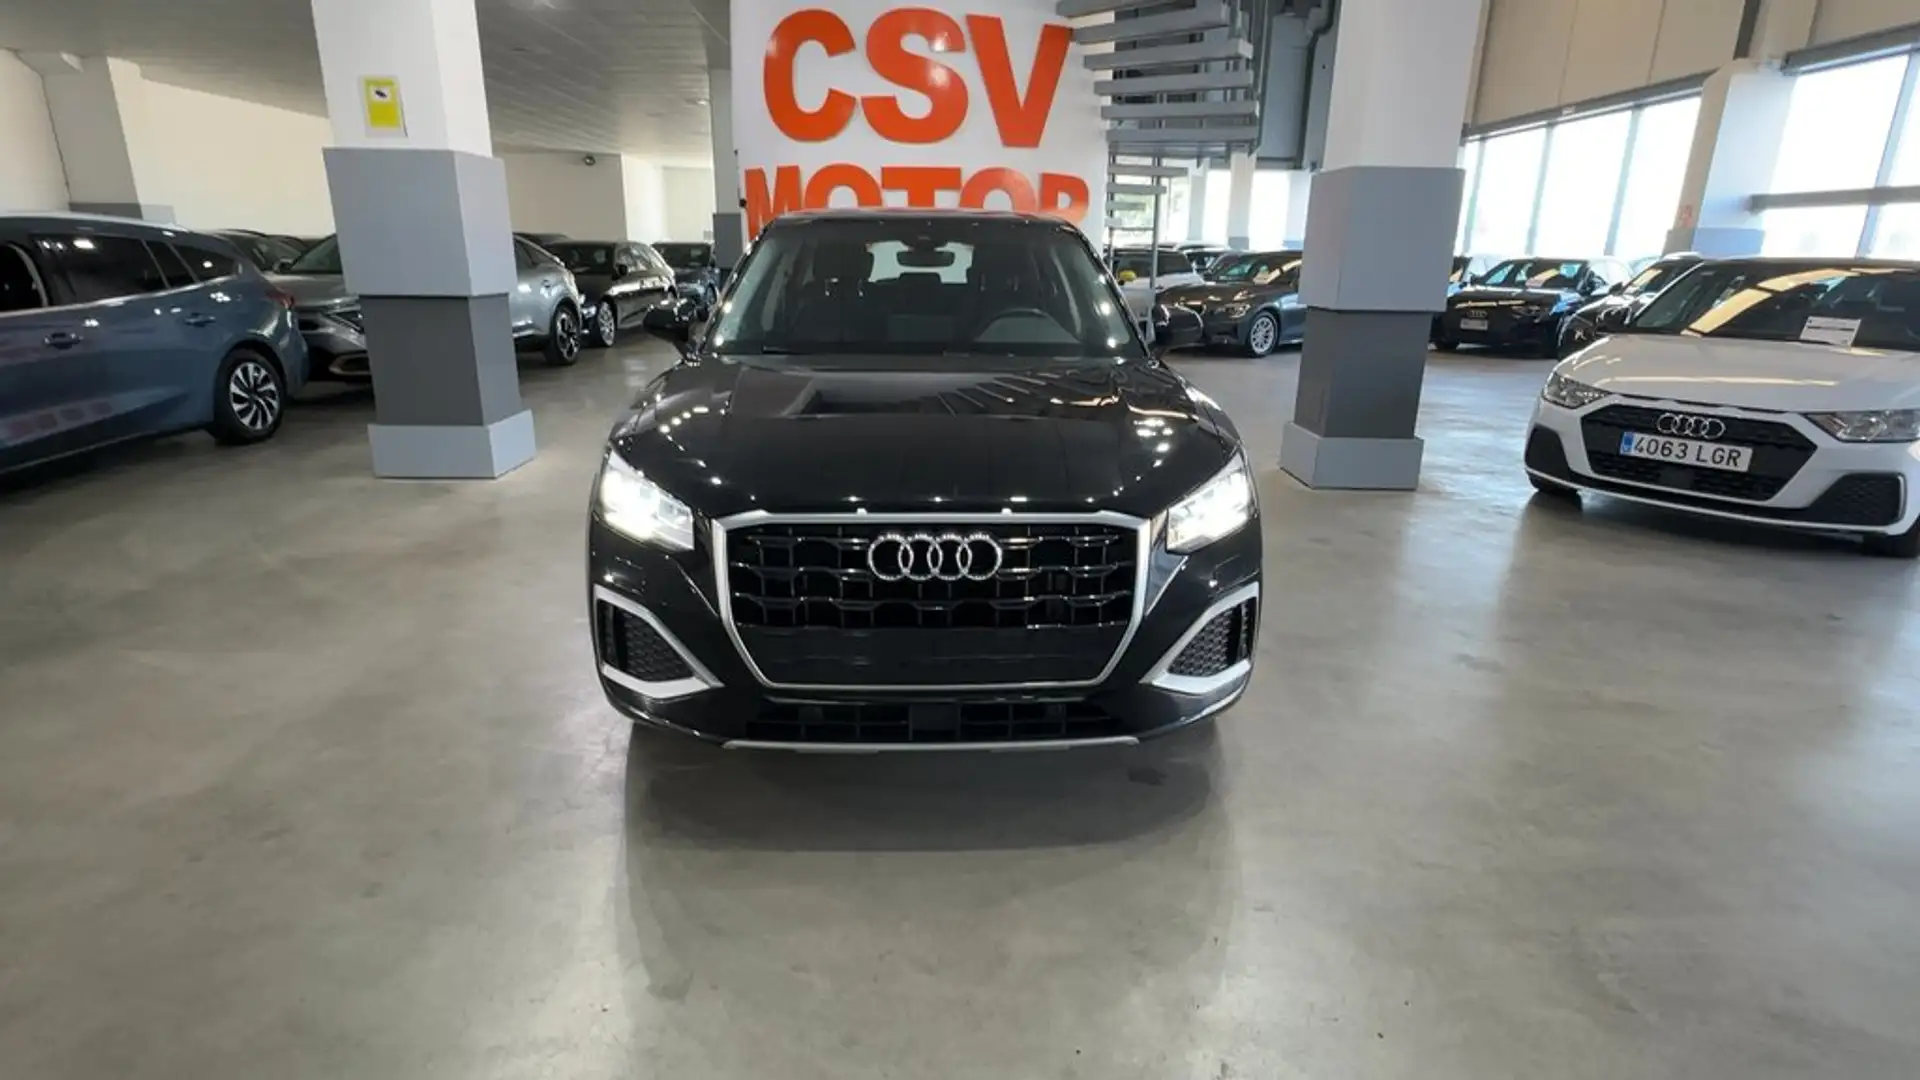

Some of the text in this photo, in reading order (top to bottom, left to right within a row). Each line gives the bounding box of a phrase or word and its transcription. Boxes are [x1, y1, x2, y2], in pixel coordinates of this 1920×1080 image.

[763, 8, 1074, 148] CSV
[1634, 437, 1742, 467] 4063 LGR
